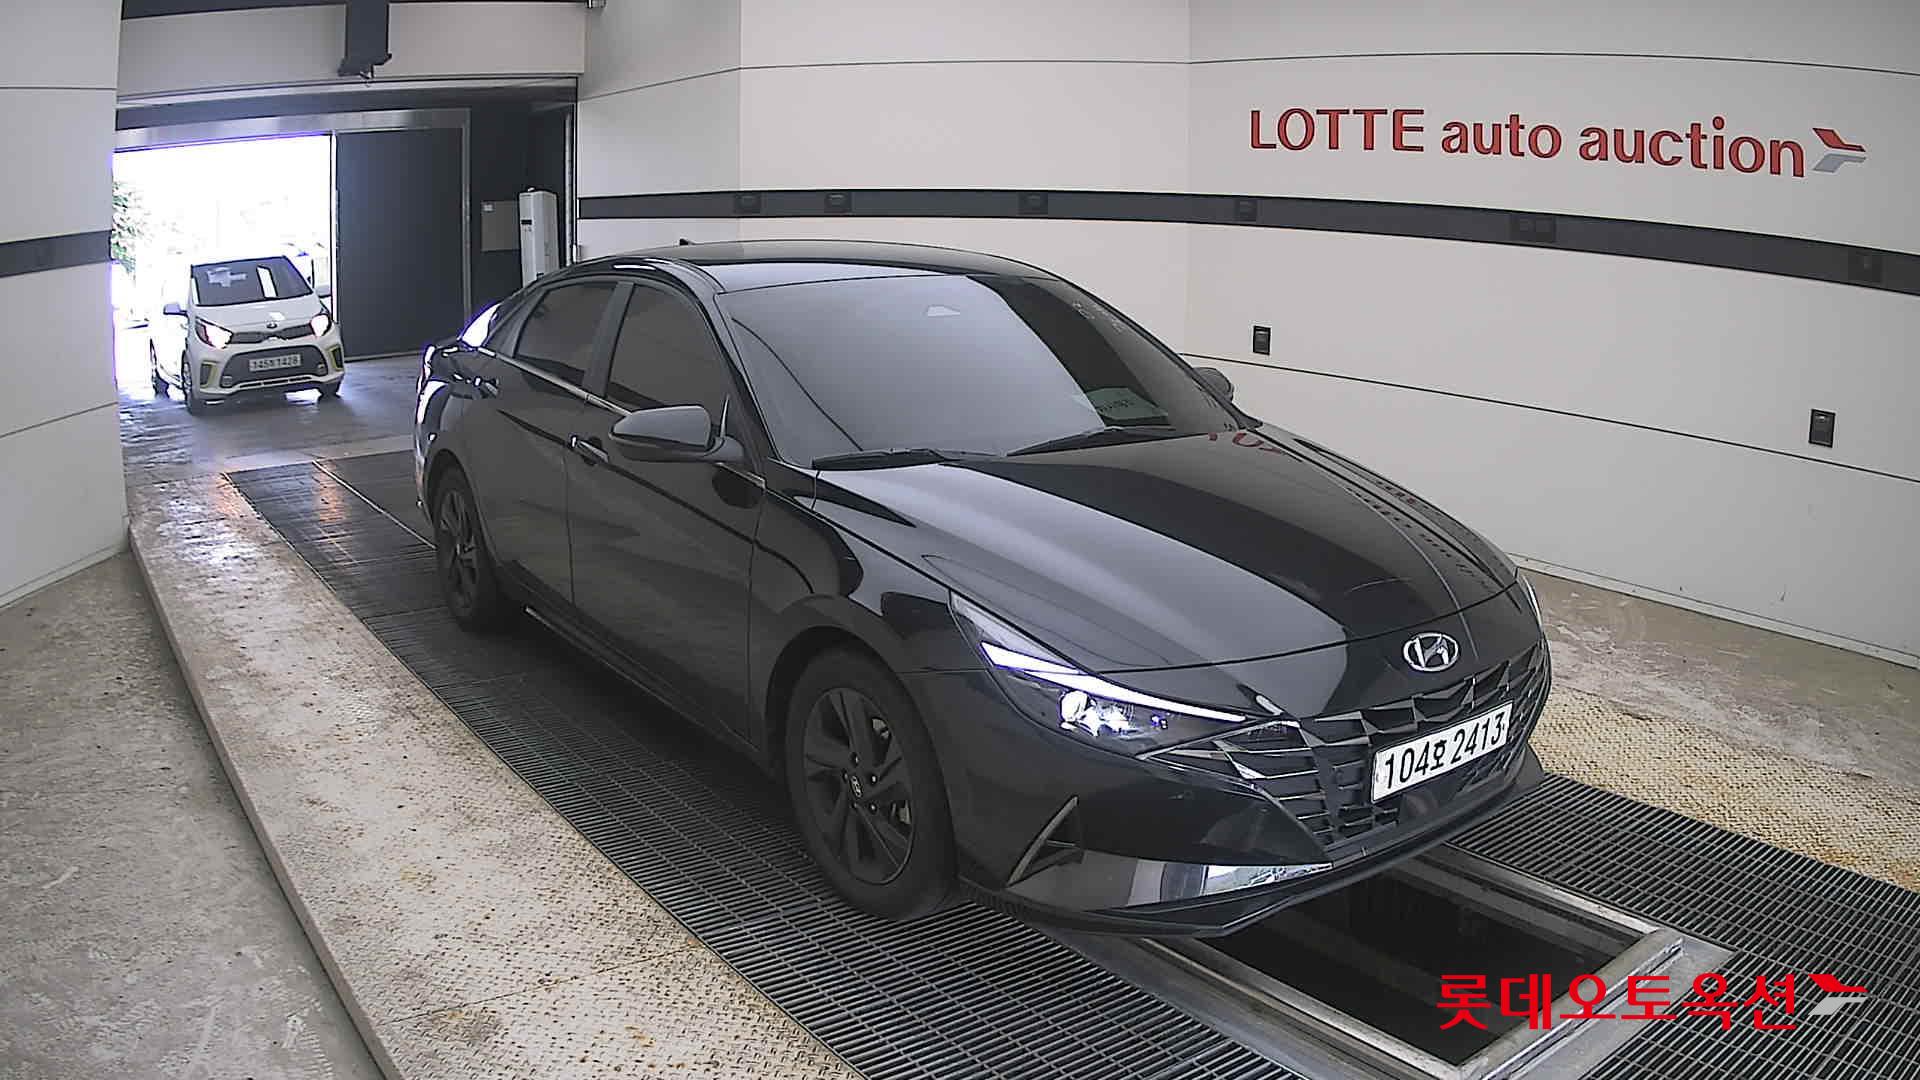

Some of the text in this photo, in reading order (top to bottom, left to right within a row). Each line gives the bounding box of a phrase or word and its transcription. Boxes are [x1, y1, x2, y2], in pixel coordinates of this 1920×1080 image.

[1250, 108, 1805, 177] LOTTE auto auction
